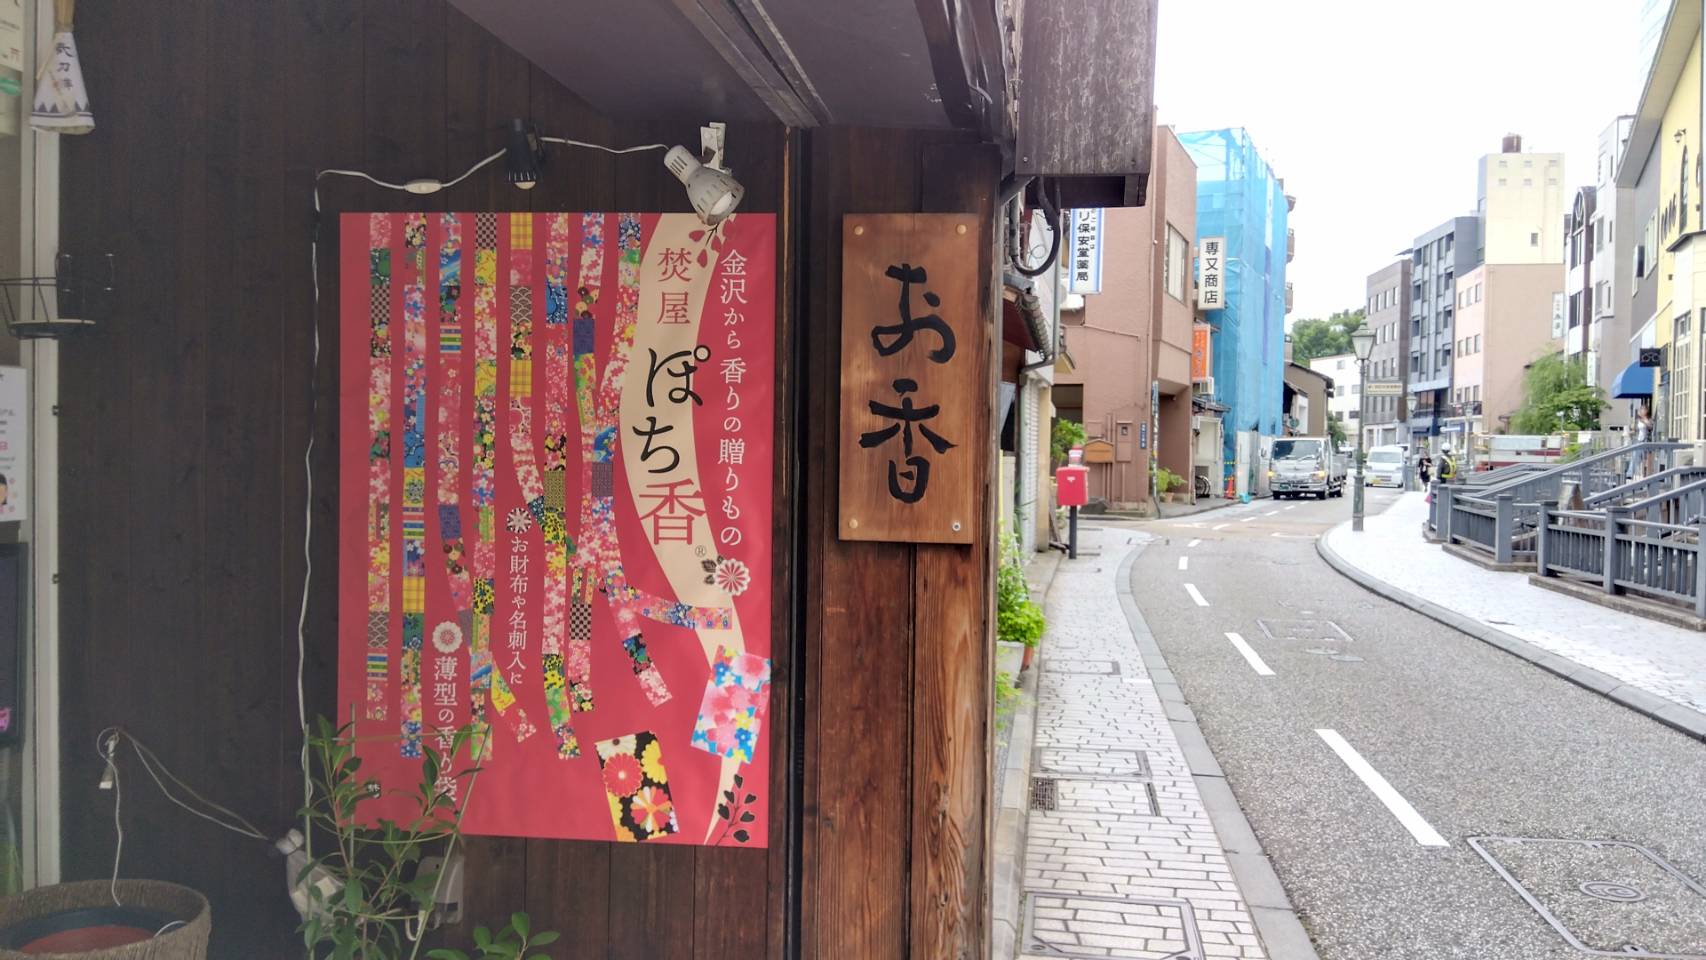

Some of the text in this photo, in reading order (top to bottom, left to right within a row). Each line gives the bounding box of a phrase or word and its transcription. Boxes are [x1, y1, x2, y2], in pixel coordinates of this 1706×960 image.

[718, 249, 748, 546] 金沢から香りの贈りもの
[858, 262, 958, 504] お香
[506, 536, 530, 685] お財布や名刺入に
